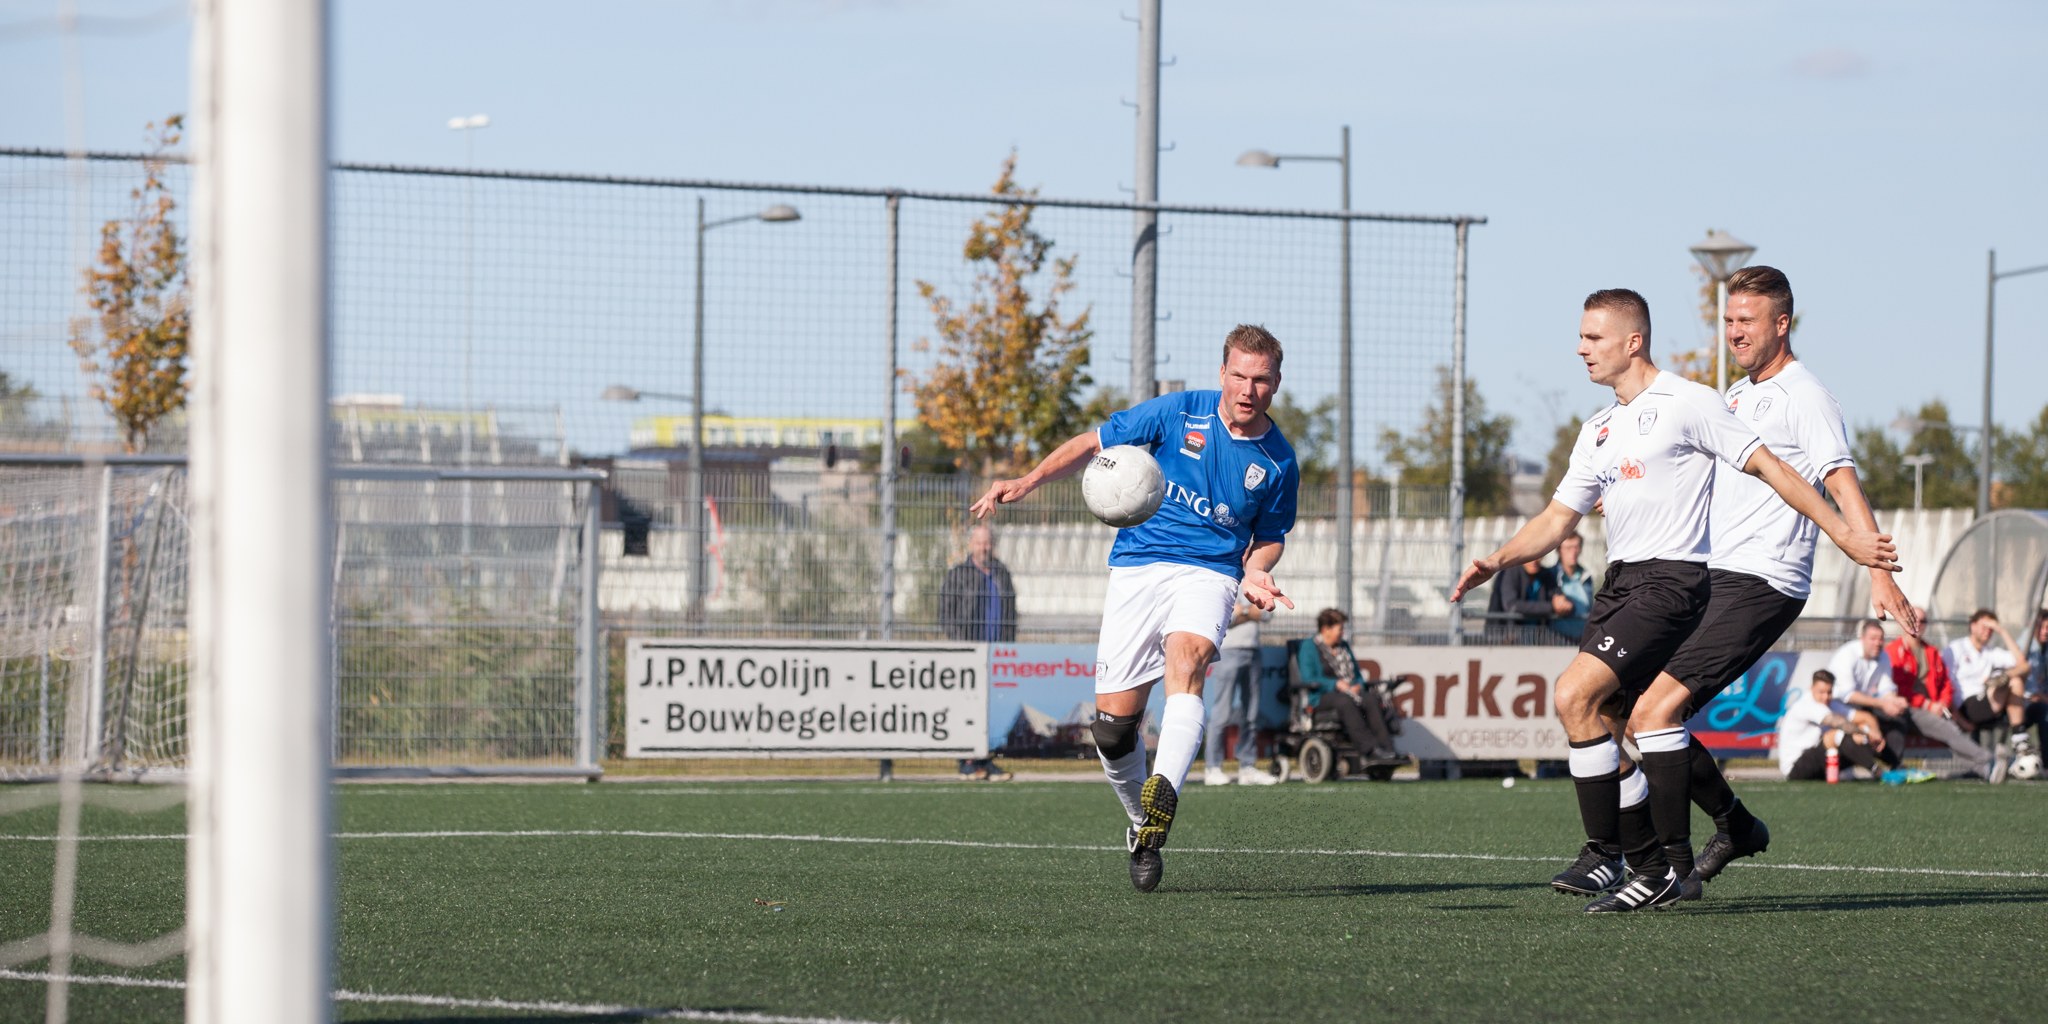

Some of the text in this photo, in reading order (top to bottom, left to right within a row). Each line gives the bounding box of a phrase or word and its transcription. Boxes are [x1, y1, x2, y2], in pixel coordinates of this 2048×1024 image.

[1165, 479, 1212, 517] ING
[1597, 635, 1615, 652] 3
[638, 656, 831, 696] J.P.M.Colijn
[870, 659, 976, 690] Leiden
[1357, 657, 1560, 720] arka
[666, 702, 949, 741] Bouwbegeleiding
